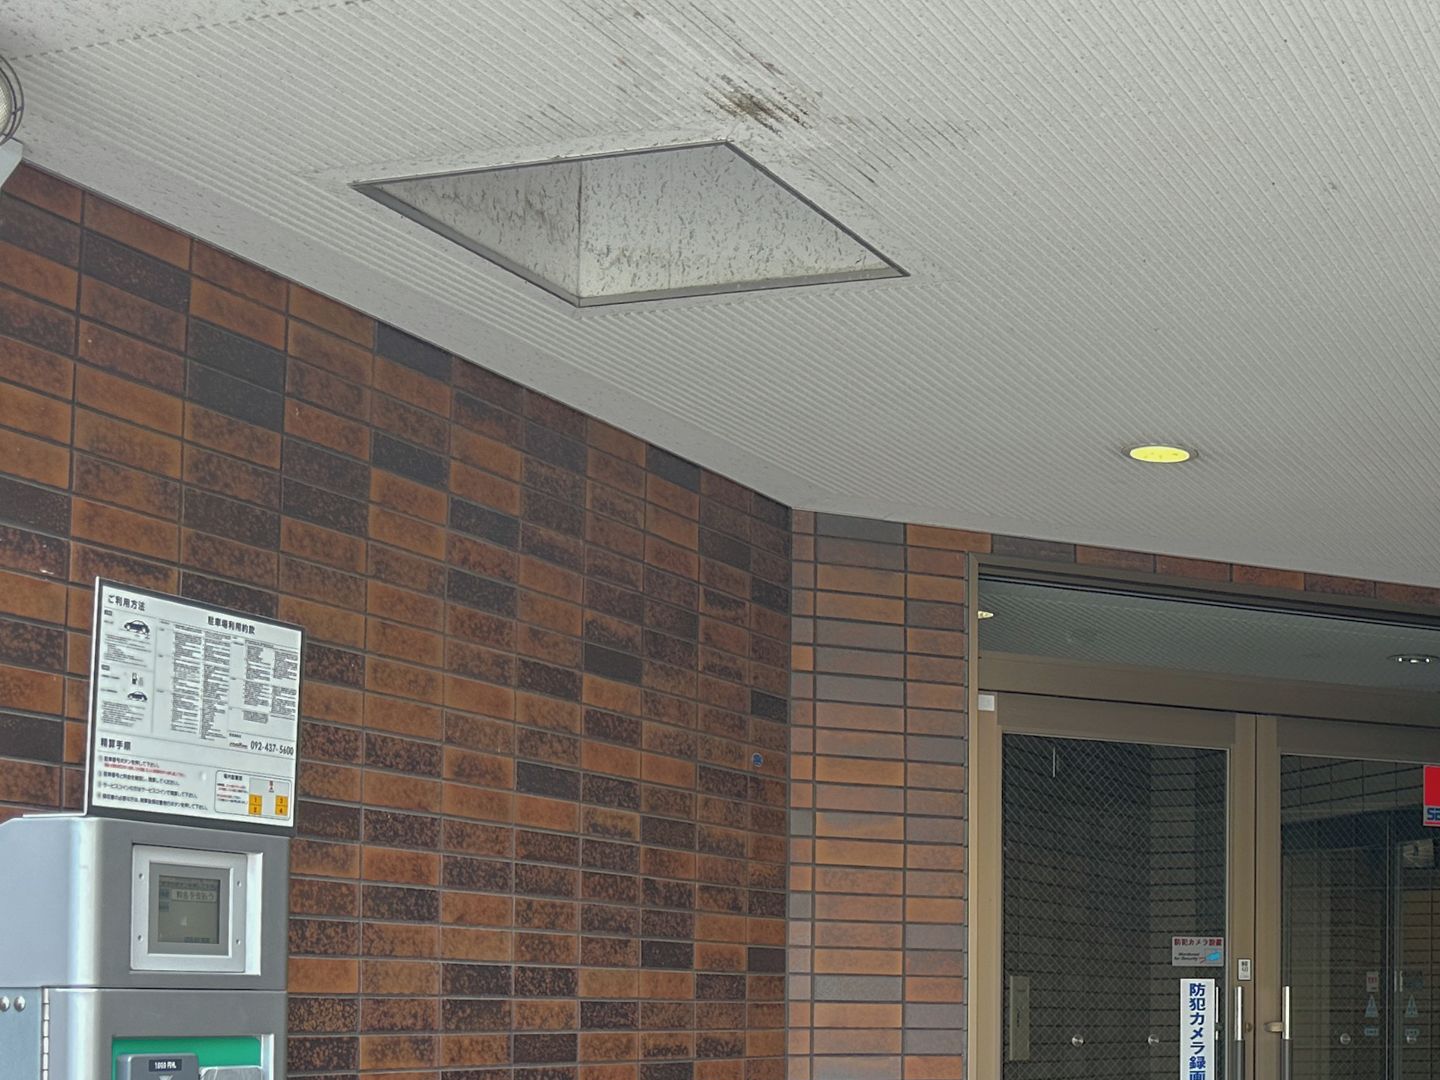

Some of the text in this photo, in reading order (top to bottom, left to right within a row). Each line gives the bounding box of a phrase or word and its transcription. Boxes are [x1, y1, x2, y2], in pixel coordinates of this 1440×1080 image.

[108, 595, 146, 612] ご利用方法
[207, 615, 256, 635] 駐車場利用約款
[100, 737, 131, 751] 精算手順
[250, 741, 294, 756] 092-437-5600
[1174, 938, 1223, 946] 防犯カメラ設置
